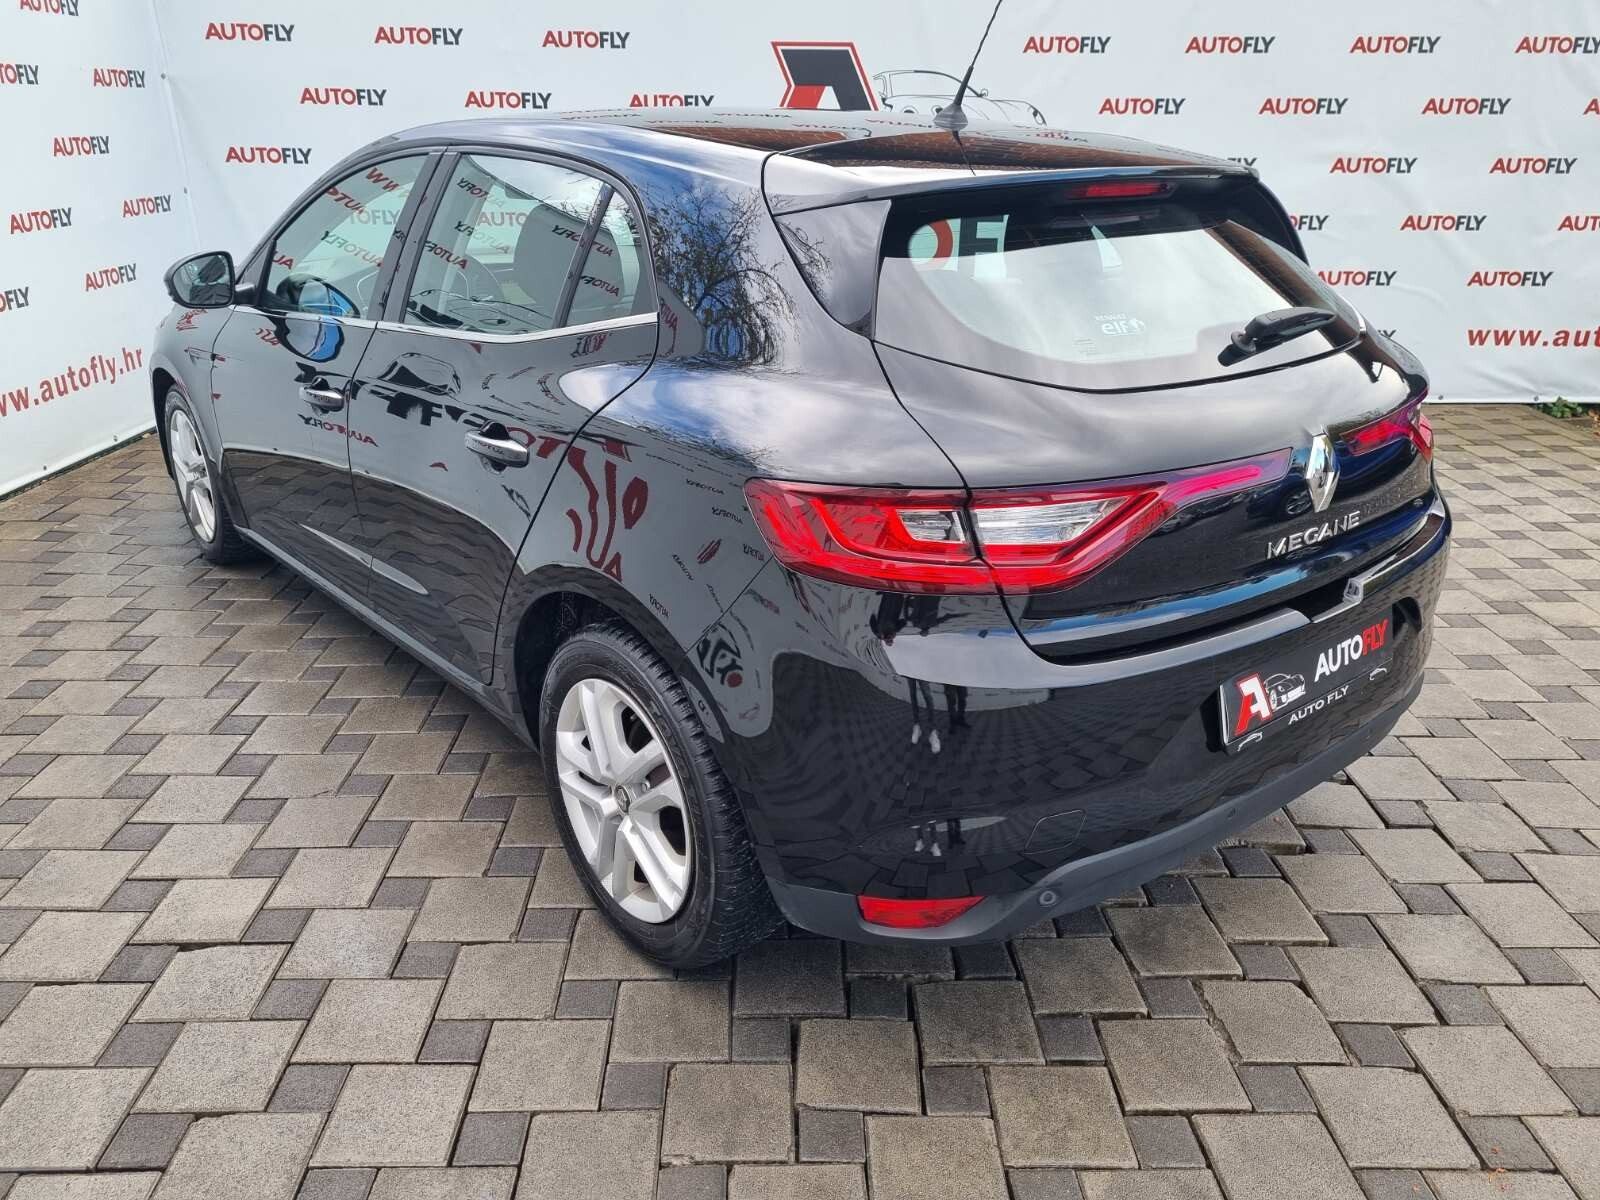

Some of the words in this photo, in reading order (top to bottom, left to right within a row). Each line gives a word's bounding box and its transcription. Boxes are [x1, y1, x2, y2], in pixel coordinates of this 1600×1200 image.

[205, 23, 295, 42] AUTOFLY
[374, 27, 463, 46] AUTOFLY
[542, 31, 630, 49] AUTOFLY
[1023, 36, 1111, 54] AUTOFLY
[1185, 36, 1275, 54] AUTOFLY
[1350, 36, 1441, 54] AUTOFLY
[1515, 36, 1600, 54] AUTOFLY
[0, 62, 39, 85] TOFLY
[94, 68, 145, 88] AUTOFLY
[300, 88, 387, 106] AUTOFLY
[467, 91, 552, 110] AUTOFLY
[1099, 98, 1186, 115] AUTOFLY
[1259, 98, 1348, 115] AUTOFLY
[1421, 98, 1512, 115] AUTOFLY
[54, 136, 110, 157] AUTOFLY
[225, 147, 312, 165] AUTOFLY
[1330, 157, 1418, 174] AUTOFLY
[1489, 157, 1578, 174] AUTOFLY
[122, 195, 171, 218] AUTOFLY
[10, 207, 72, 234] AUTOFLY
[1400, 215, 1487, 231] AUTOFLY
[85, 263, 137, 292] AUTOFLY
[1467, 271, 1554, 286] AUTOFLY
[1267, 511, 1361, 560] MEGANE
[1314, 618, 1388, 683] AUTOFLY
[1288, 698, 1325, 725] AUTO
[1326, 685, 1350, 705] FLY
